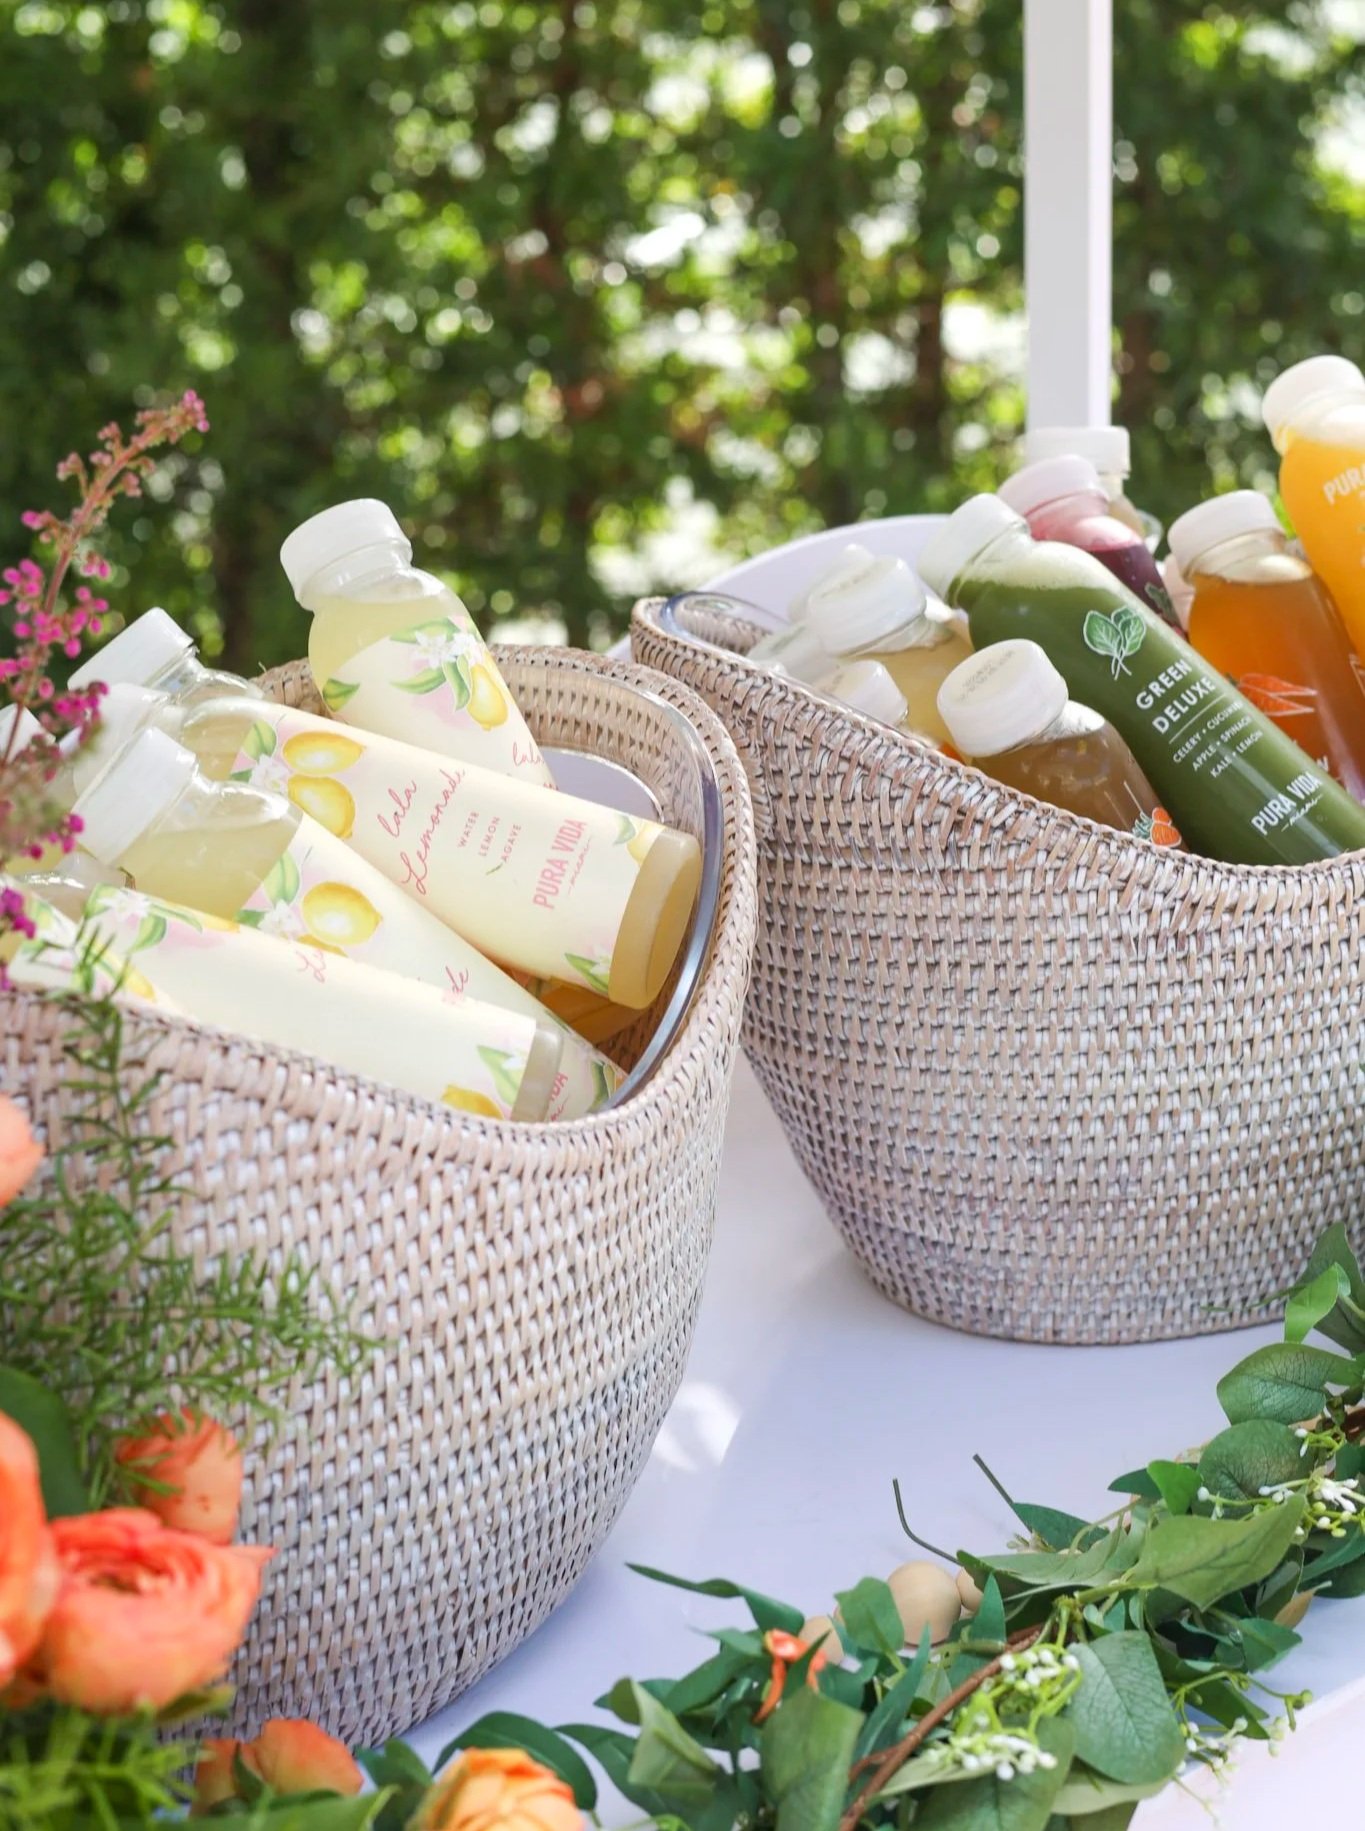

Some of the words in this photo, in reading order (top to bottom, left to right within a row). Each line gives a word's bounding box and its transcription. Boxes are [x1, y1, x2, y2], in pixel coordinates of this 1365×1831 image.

[1135, 658, 1193, 710] GREEN
[1152, 675, 1217, 735] DELUXE
[1173, 732, 1202, 763] CELERY
[1192, 743, 1217, 771] APPLE
[1210, 755, 1233, 778] KALE
[1236, 730, 1264, 754] LEMON
[1251, 793, 1297, 836] PURA
[1286, 771, 1323, 800] VIDA
[457, 811, 480, 848] WATER
[478, 816, 500, 857] LEMON
[501, 823, 522, 863] AGAVE
[533, 857, 569, 910] PURA
[552, 818, 588, 853] VIDA
